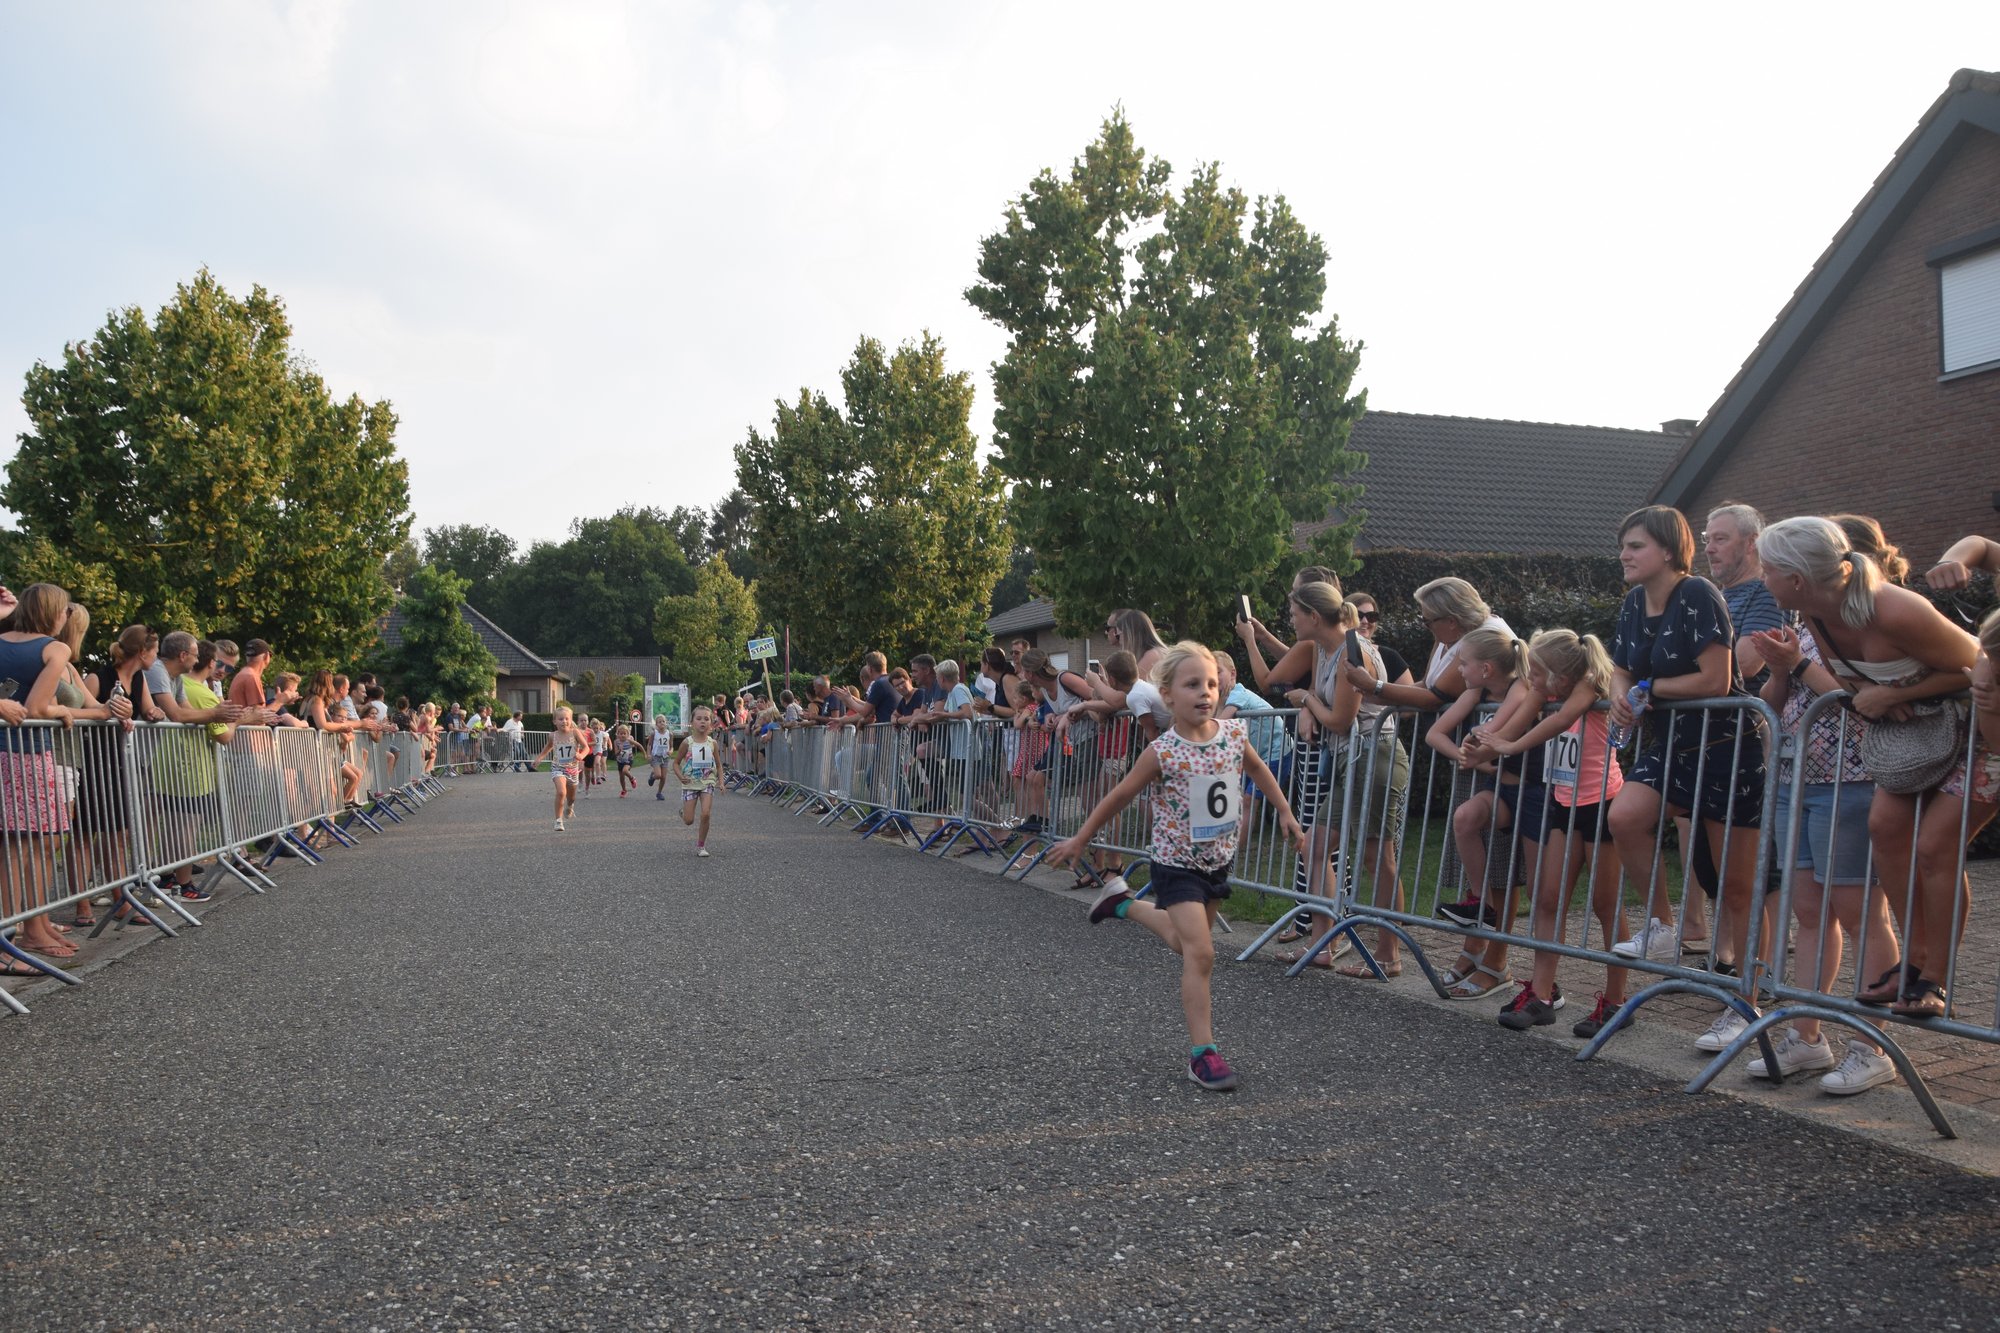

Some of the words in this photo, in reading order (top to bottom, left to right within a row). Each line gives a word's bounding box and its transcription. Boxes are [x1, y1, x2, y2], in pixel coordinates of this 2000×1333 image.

[750, 641, 774, 655] START
[659, 737, 667, 745] 12
[559, 746, 572, 758] 17
[699, 746, 705, 760] 1
[1550, 735, 1578, 769] 70
[1206, 780, 1228, 819] 6
